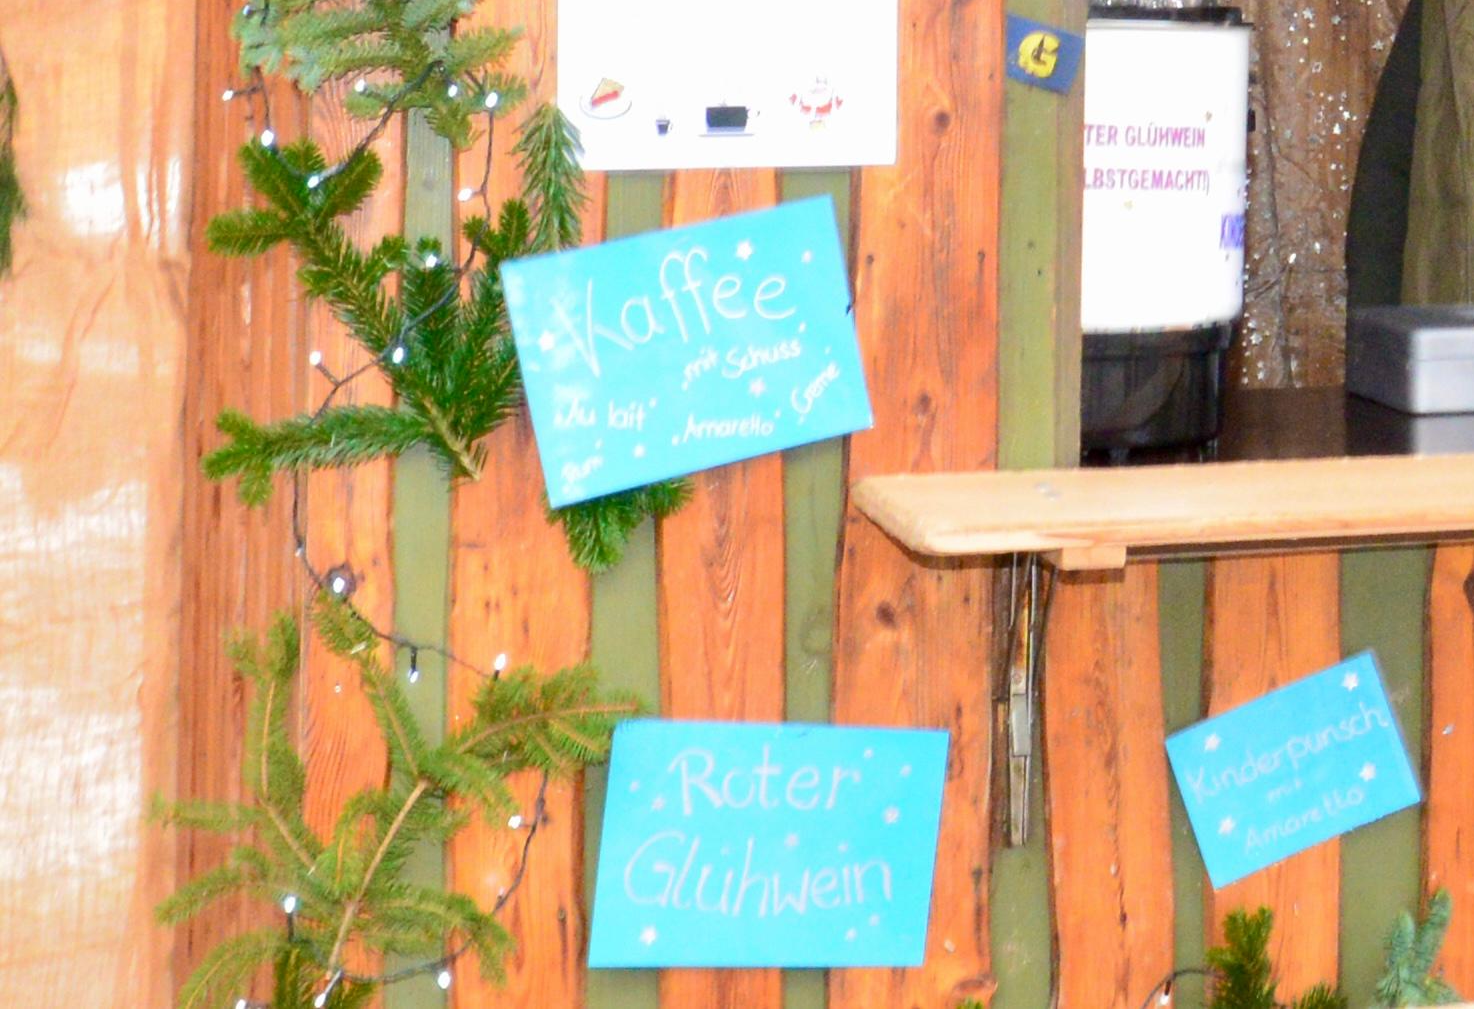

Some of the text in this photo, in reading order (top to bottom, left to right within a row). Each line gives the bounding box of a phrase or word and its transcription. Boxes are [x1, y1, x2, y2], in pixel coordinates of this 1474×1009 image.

[1125, 122, 1205, 148] GLÜHWEIN
[552, 247, 796, 378] Kaffee
[667, 743, 862, 817] Roter
[623, 830, 893, 918] Glühwein
